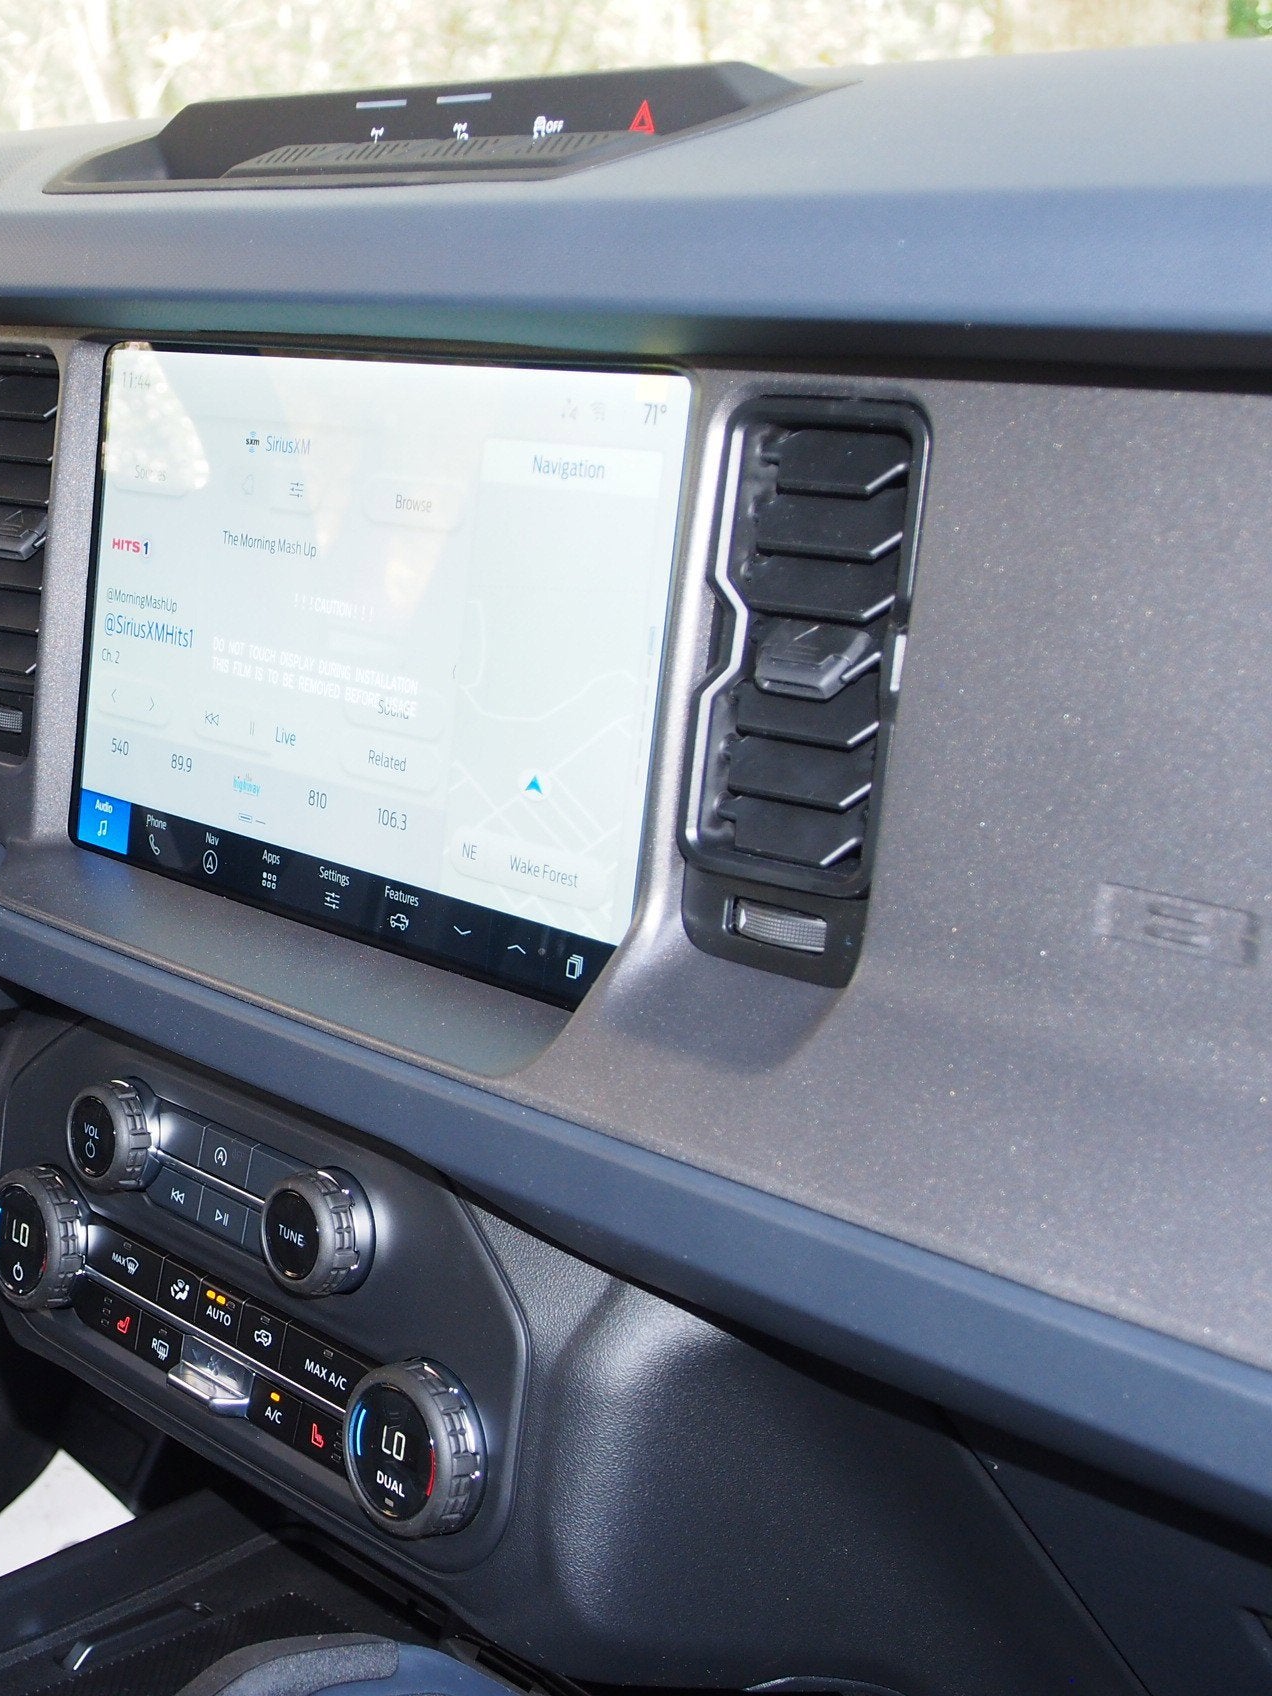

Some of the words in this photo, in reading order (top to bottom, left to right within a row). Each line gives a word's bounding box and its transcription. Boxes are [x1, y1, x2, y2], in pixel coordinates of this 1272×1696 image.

[546, 120, 564, 134] OFF
[265, 435, 310, 455] SiriusXM
[532, 455, 605, 480] Navigation
[395, 494, 432, 512] Browse
[112, 538, 140, 554] HITS
[143, 541, 150, 555] 1
[222, 529, 239, 546] The
[239, 533, 276, 555] Morning
[277, 538, 302, 556] Mash
[303, 541, 317, 559] Up
[106, 587, 178, 614] @MorningMashUp
[104, 612, 194, 649] @SiriusXMHits1
[114, 650, 121, 664] 2
[213, 636, 225, 652] DO
[228, 640, 245, 656] NOT
[249, 644, 276, 664] TOUCH
[279, 650, 316, 672] DISPLAY
[318, 659, 351, 681] DURING
[355, 666, 419, 696] INSTALLATION
[212, 656, 229, 674] THIS
[232, 660, 252, 679] FILM
[255, 665, 264, 681] IS
[268, 668, 279, 685] TO
[283, 672, 294, 690] BE
[298, 675, 341, 700] REMOVED
[345, 686, 381, 709] BEFORE
[385, 696, 418, 718] USAGE
[275, 726, 296, 746] Live
[111, 737, 130, 756] 540
[170, 753, 193, 773] 89.9
[368, 749, 407, 772] Related
[94, 799, 114, 814] Audio
[308, 789, 327, 809] 810
[377, 807, 408, 831] 106.3
[146, 813, 168, 831] Phone
[205, 831, 220, 846] Nav
[262, 849, 281, 865] Apps
[461, 841, 478, 861] NE
[318, 865, 351, 887] Settings
[509, 855, 541, 878] Wake
[541, 864, 579, 888] Forest
[384, 885, 420, 907] Features
[83, 1122, 99, 1140] VOL
[278, 1223, 305, 1248] TUNE
[111, 1252, 126, 1267] MAX
[205, 1304, 232, 1327] AUTO
[304, 1358, 327, 1381] MAX
[328, 1371, 348, 1391] A/C
[264, 1405, 283, 1424] A/C
[376, 1469, 406, 1498] DUAL
